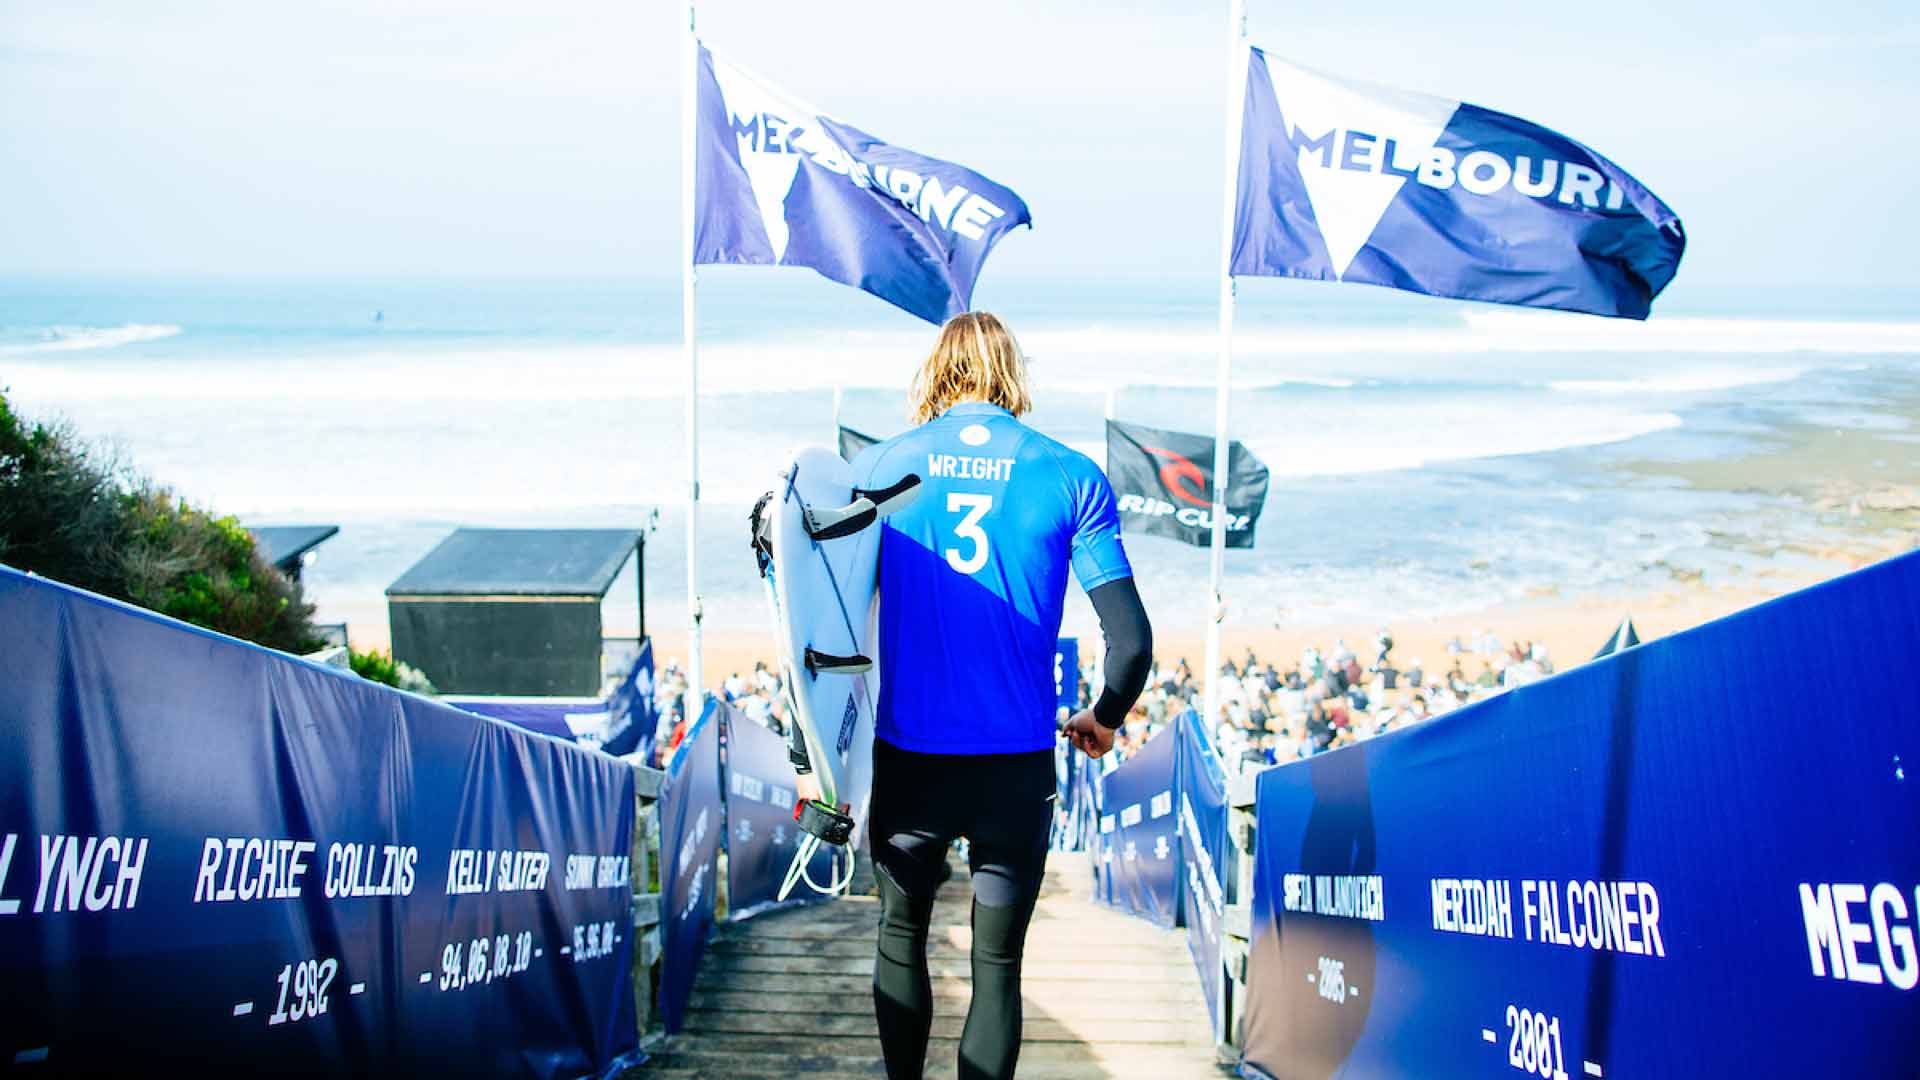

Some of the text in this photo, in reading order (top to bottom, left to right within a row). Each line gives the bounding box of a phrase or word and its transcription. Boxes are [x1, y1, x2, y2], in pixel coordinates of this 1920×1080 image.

[927, 453, 1016, 481] WRIGHT
[945, 492, 993, 575] 3
[1117, 493, 1176, 517] RIP
[193, 837, 418, 903] RICHIE COLLINS
[446, 849, 550, 895] KELLY SLATER
[1431, 878, 1666, 957] NERIDAH FALCONER
[1799, 883, 1920, 991] MEG
[268, 957, 339, 1025] 1992
[1505, 1003, 1570, 1080] 2001
